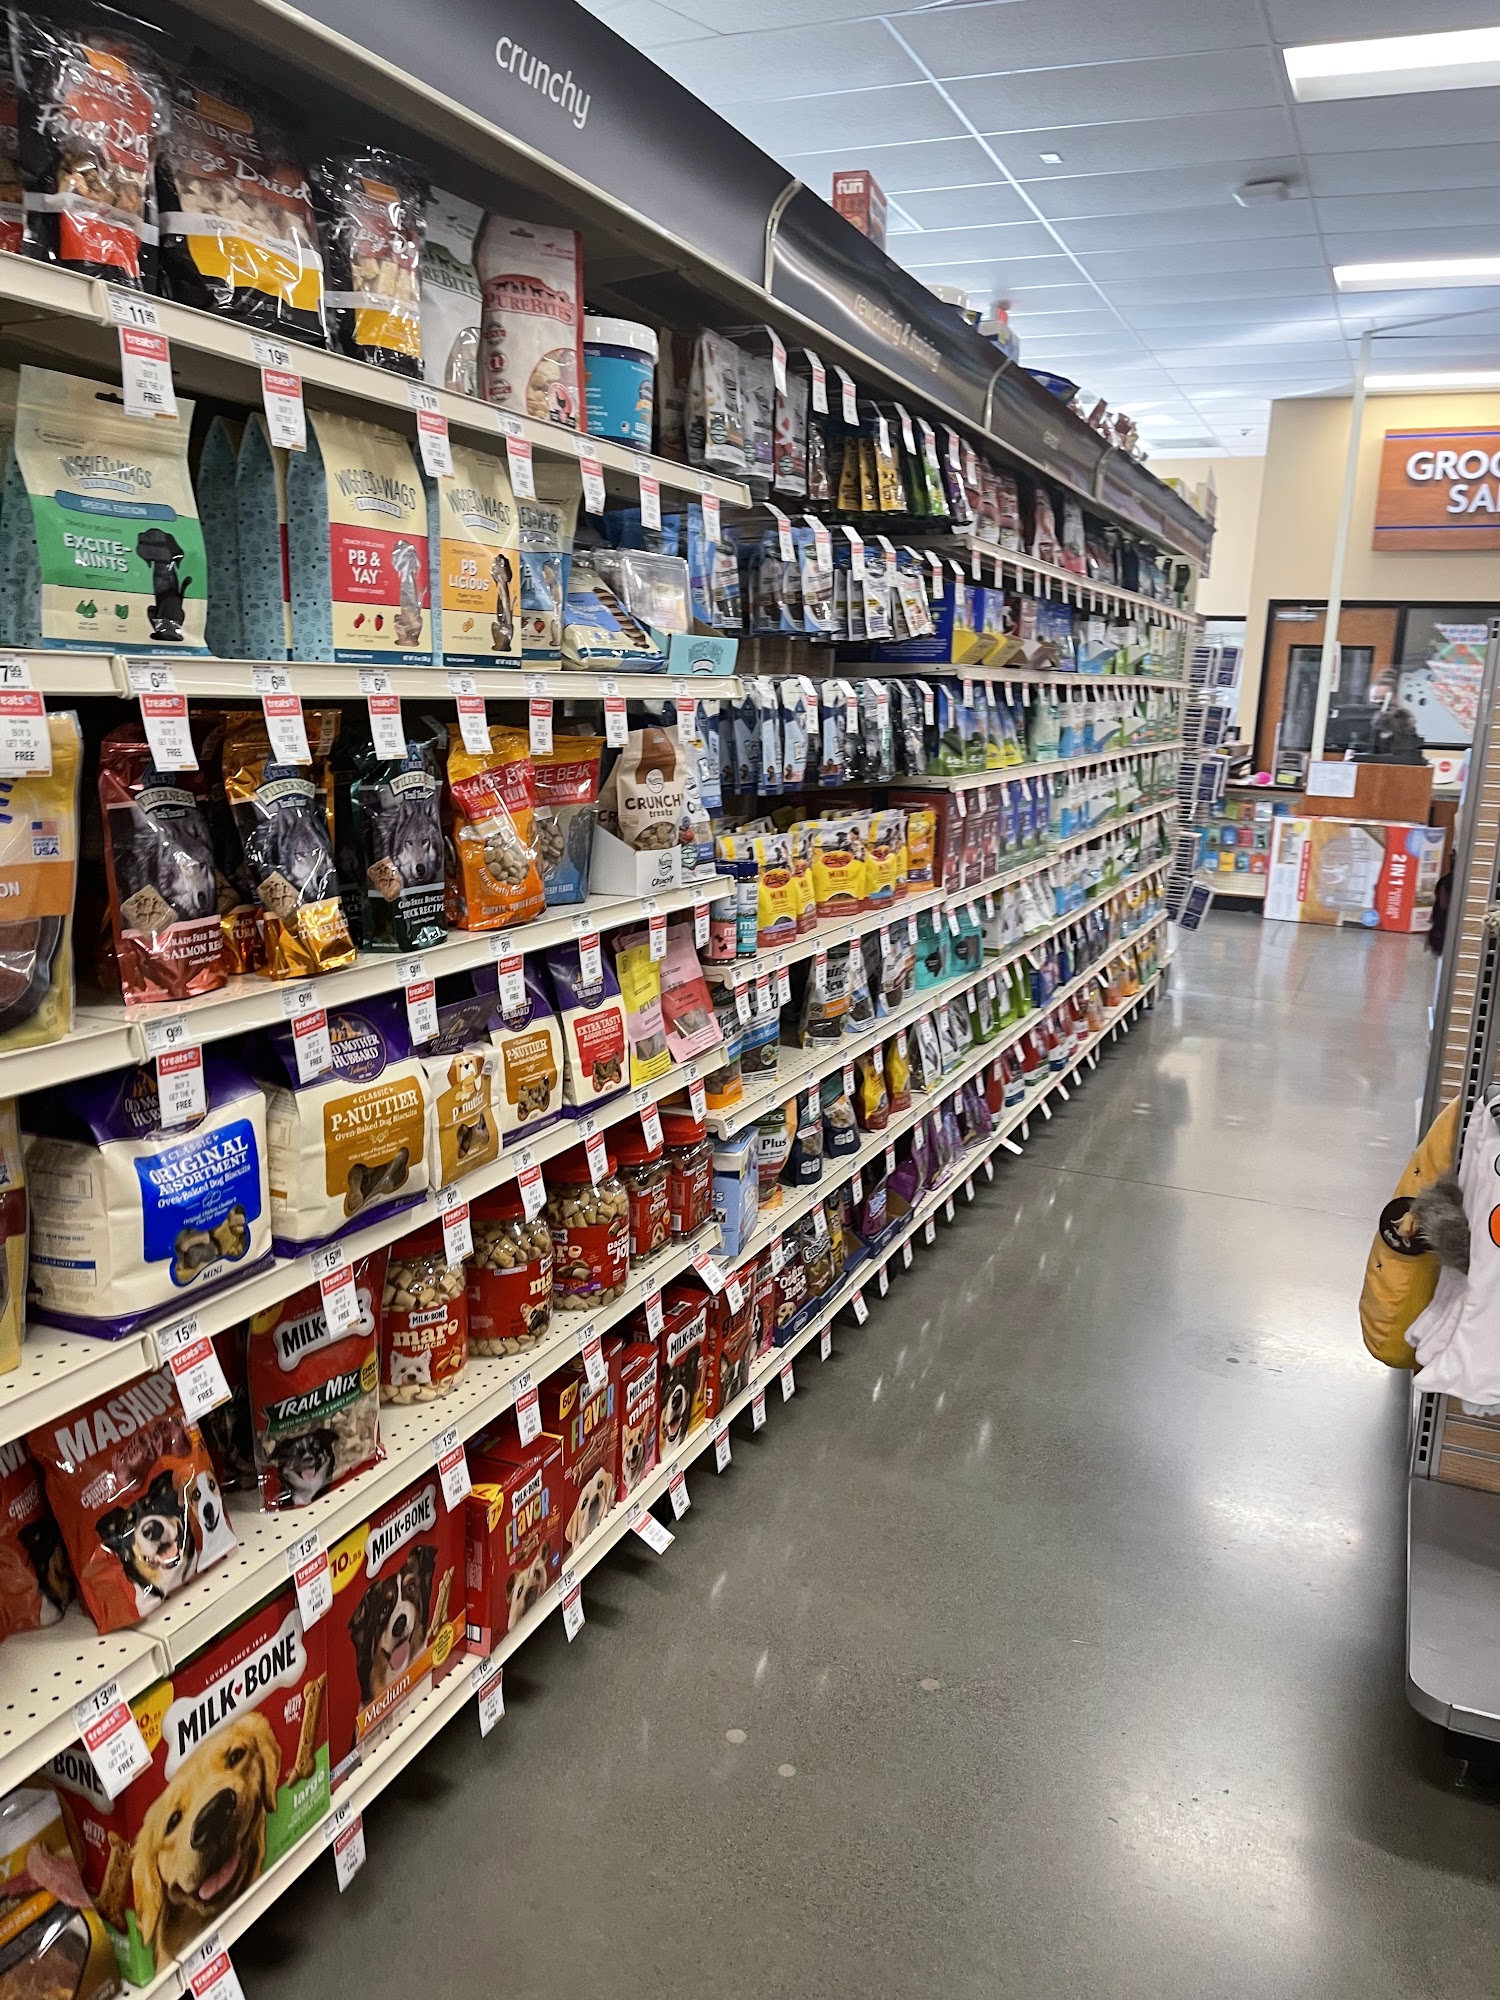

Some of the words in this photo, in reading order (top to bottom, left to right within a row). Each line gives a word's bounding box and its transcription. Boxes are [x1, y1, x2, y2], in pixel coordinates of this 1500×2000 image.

[495, 36, 591, 130] crunchy
[172, 106, 259, 154] SOURCE
[234, 156, 312, 201] Dried
[836, 177, 865, 196] fun
[484, 292, 572, 324] PUREBITES
[382, 475, 416, 510] WAGS
[80, 500, 112, 511] SPECIAL
[113, 504, 148, 515] EDITION
[483, 492, 511, 526] WAGS
[63, 532, 132, 555] EXCITE-
[75, 549, 129, 572] MINTS
[348, 549, 367, 567] PB
[369, 552, 381, 567] &
[461, 559, 477, 575] PB
[352, 566, 379, 585] YAY
[448, 575, 490, 591] LICIOUS
[145, 698, 172, 708] treats
[15, 751, 36, 761] FREE
[167, 748, 183, 757] FREE
[557, 764, 591, 780] BEAR
[135, 788, 196, 806] WILDERNESS
[625, 795, 684, 810] CRUNCH
[649, 809, 673, 817] treats
[34, 847, 59, 856] USA
[419, 902, 446, 915] RECIPE
[162, 940, 208, 961] SALMON
[408, 984, 426, 999] treats
[294, 1015, 317, 1031] treats
[577, 1021, 599, 1036] EXTRA
[600, 1015, 621, 1029] TASTY
[340, 1035, 380, 1054] MOTHER
[507, 1040, 548, 1061] P-NUTTIER
[161, 1052, 189, 1068] treats
[310, 1055, 323, 1065] FREE
[332, 1049, 379, 1069] HUBBARD
[175, 1082, 186, 1091] BUY
[357, 1088, 389, 1105] CLASSIC
[176, 1099, 193, 1110] FREE
[331, 1090, 419, 1131] P-NUTTIER
[334, 1120, 378, 1142] Oven-Baked
[379, 1118, 392, 1132] Dog
[393, 1109, 417, 1125] Biscuits
[762, 1137, 787, 1150] Plus
[150, 1136, 248, 1184] ORIGINAL
[159, 1152, 248, 1196] ASSORTMENT
[157, 1181, 209, 1208] Oven-Baked
[209, 1174, 224, 1191] Dog
[225, 1164, 251, 1183] Biscuits
[445, 1207, 464, 1222] treats
[203, 1265, 223, 1280] MINI
[323, 1274, 343, 1287] treats
[412, 1310, 446, 1325] MILK-BONE
[393, 1320, 458, 1347] maro
[670, 1318, 704, 1357] MILK-BONE
[411, 1339, 447, 1352] SNACKS
[174, 1347, 199, 1367] treats
[197, 1387, 215, 1403] FREE
[275, 1392, 320, 1420] TRAIL
[326, 1372, 358, 1399] MIX
[629, 1369, 656, 1403] MILK-BONE
[562, 1390, 572, 1409] 60
[628, 1392, 656, 1426] minis
[571, 1383, 614, 1454] FLAVOR
[514, 1478, 541, 1509] MILK-BONE
[371, 1497, 431, 1565] MILK-BONE
[506, 1488, 549, 1555] FLAVOR
[330, 1552, 349, 1579] 10
[349, 1550, 362, 1566] LBS
[364, 1676, 410, 1726] Medium
[87, 1713, 115, 1741] treats
[54, 1753, 103, 1796] BONE
[118, 1756, 136, 1776] FREE
